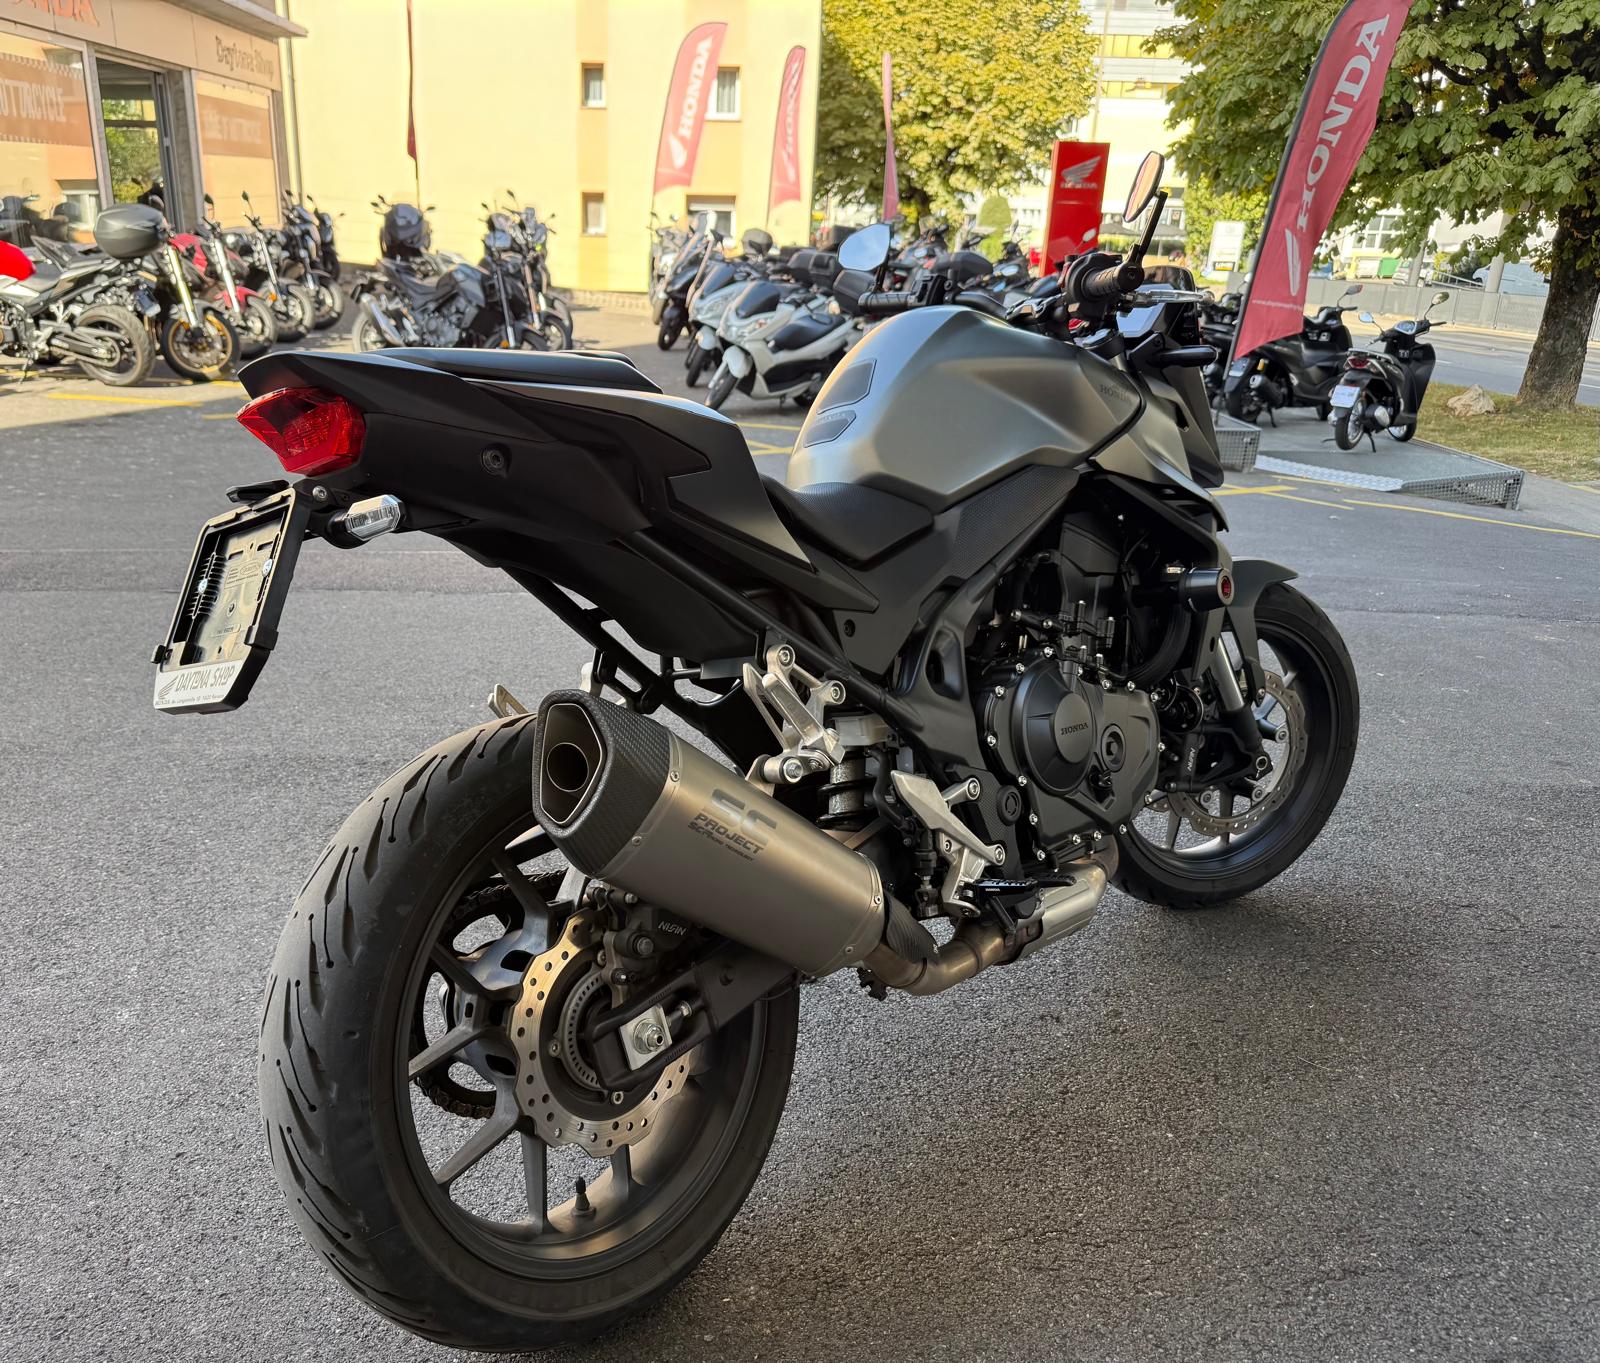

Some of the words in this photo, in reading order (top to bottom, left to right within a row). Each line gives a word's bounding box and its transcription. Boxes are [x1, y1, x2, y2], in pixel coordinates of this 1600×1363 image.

[679, 36, 713, 139] HONDA
[1297, 14, 1389, 232] HONDA
[175, 669, 212, 693] DAYTONA
[209, 664, 236, 688] SHOP
[1060, 722, 1089, 736] HONDA
[693, 812, 765, 854] PROJECT
